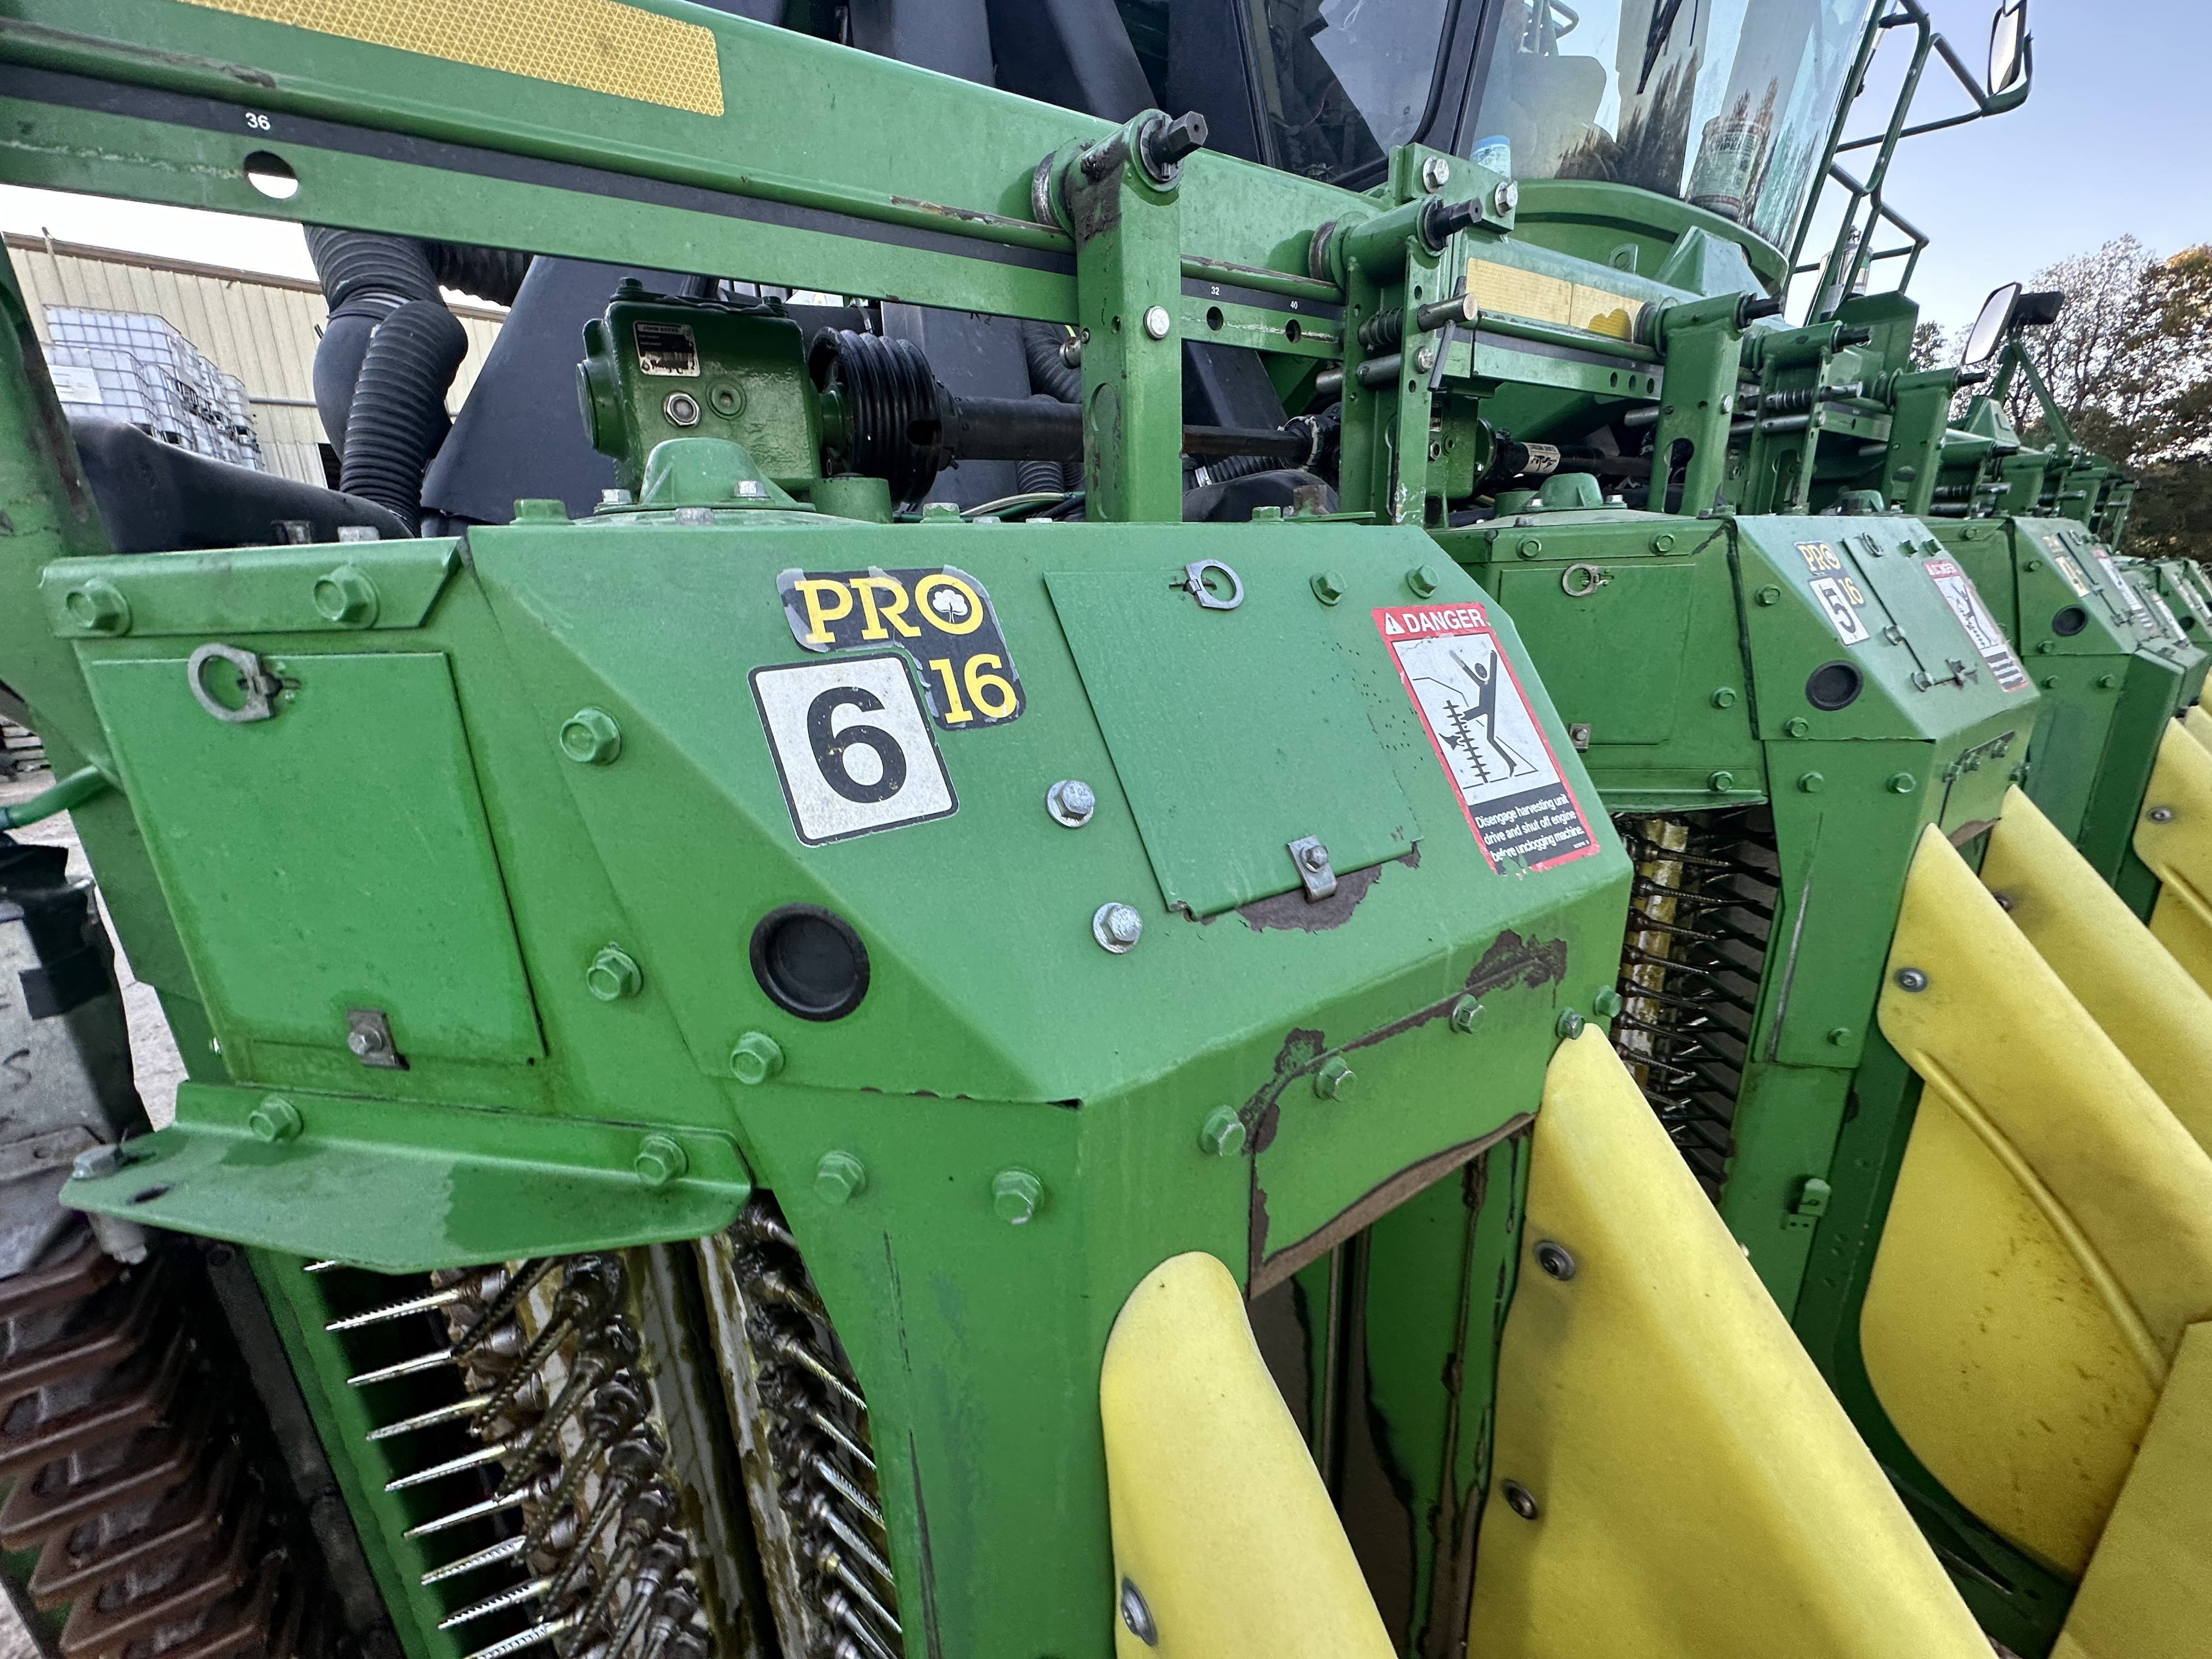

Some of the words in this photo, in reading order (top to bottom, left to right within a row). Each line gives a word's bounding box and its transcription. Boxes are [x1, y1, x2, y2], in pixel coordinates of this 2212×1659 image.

[245, 112, 271, 131] 36
[1210, 286, 1220, 296] 32
[1290, 300, 1299, 309] 40
[1797, 543, 1841, 572] PRO
[794, 574, 984, 644] PRO
[1837, 577, 1864, 605] 16
[1402, 608, 1486, 633] DANGER
[1821, 588, 1857, 634] 5
[929, 653, 1017, 724] 16
[806, 686, 907, 804] 6
[1475, 809, 1518, 829] Disengage
[1515, 799, 1556, 818] harvesting
[1554, 793, 1570, 807] unit
[1483, 831, 1506, 846] drive
[1505, 824, 1522, 839] and
[1521, 819, 1541, 834] shut
[1540, 815, 1552, 828] off
[1550, 810, 1577, 826] engine
[1489, 847, 1517, 863] before
[1515, 834, 1557, 854] unclogging
[1555, 825, 1585, 843] machine.
